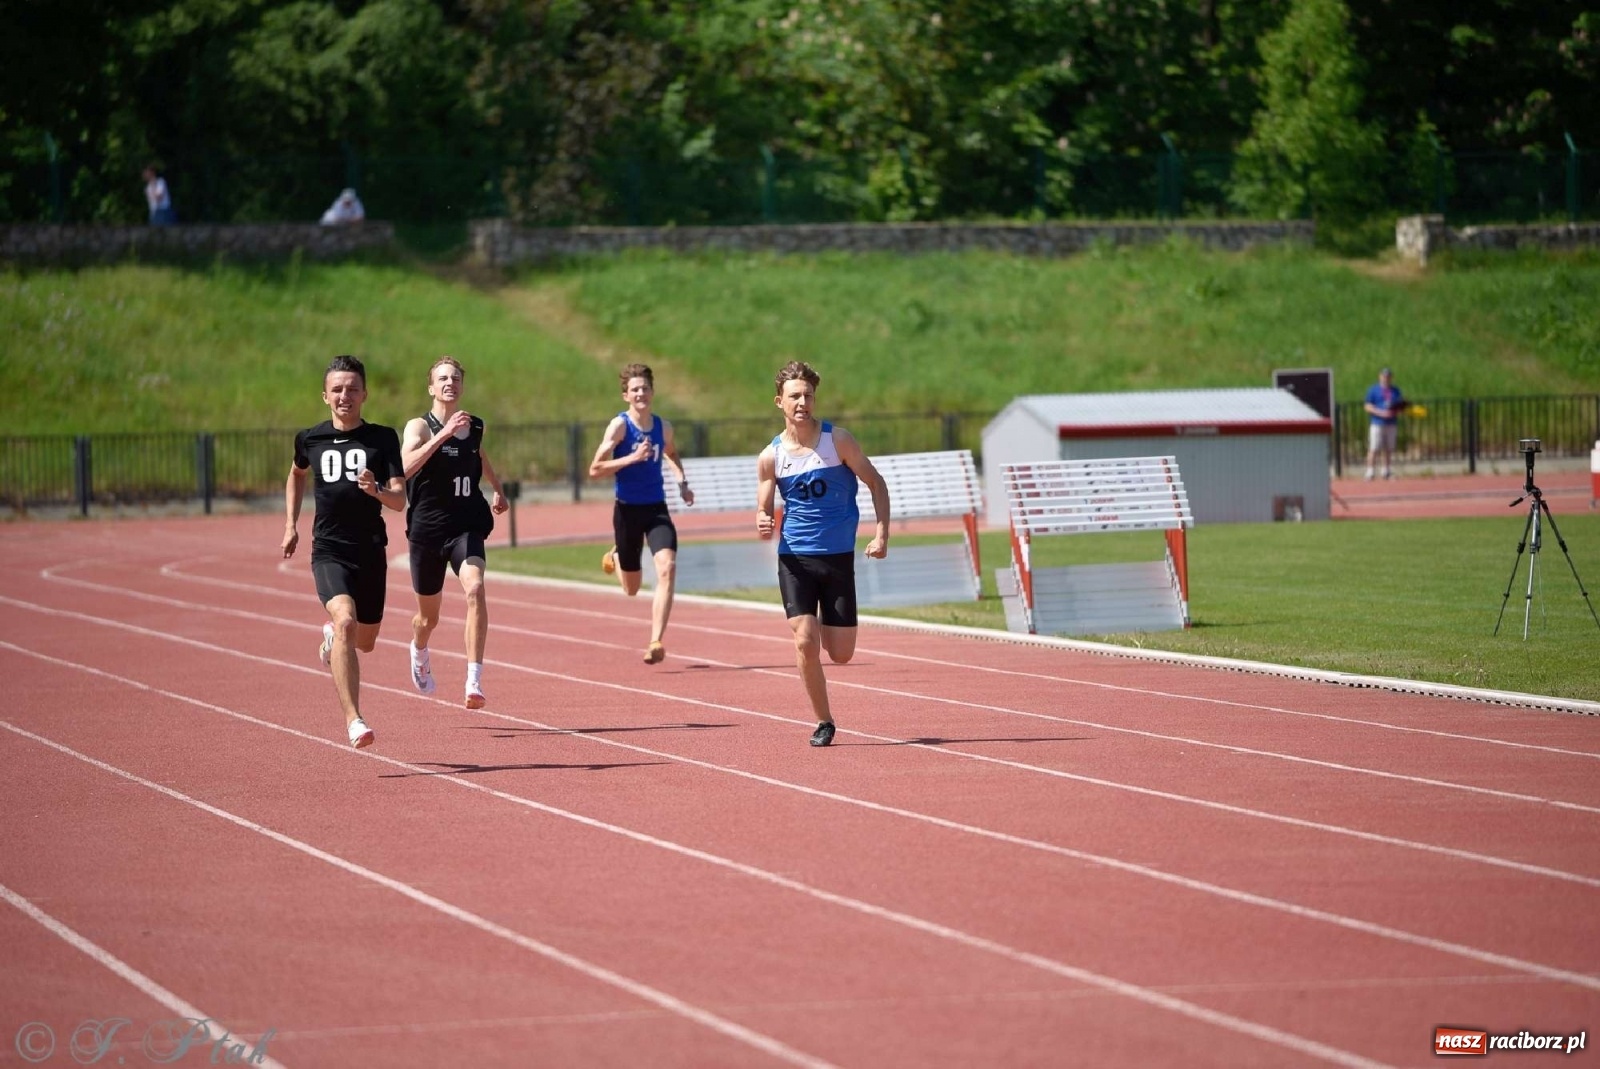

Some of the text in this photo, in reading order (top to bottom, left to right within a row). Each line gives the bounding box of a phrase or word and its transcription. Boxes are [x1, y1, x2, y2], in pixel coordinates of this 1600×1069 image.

[320, 449, 367, 483] 09
[453, 476, 471, 497] 10
[795, 479, 828, 500] 30
